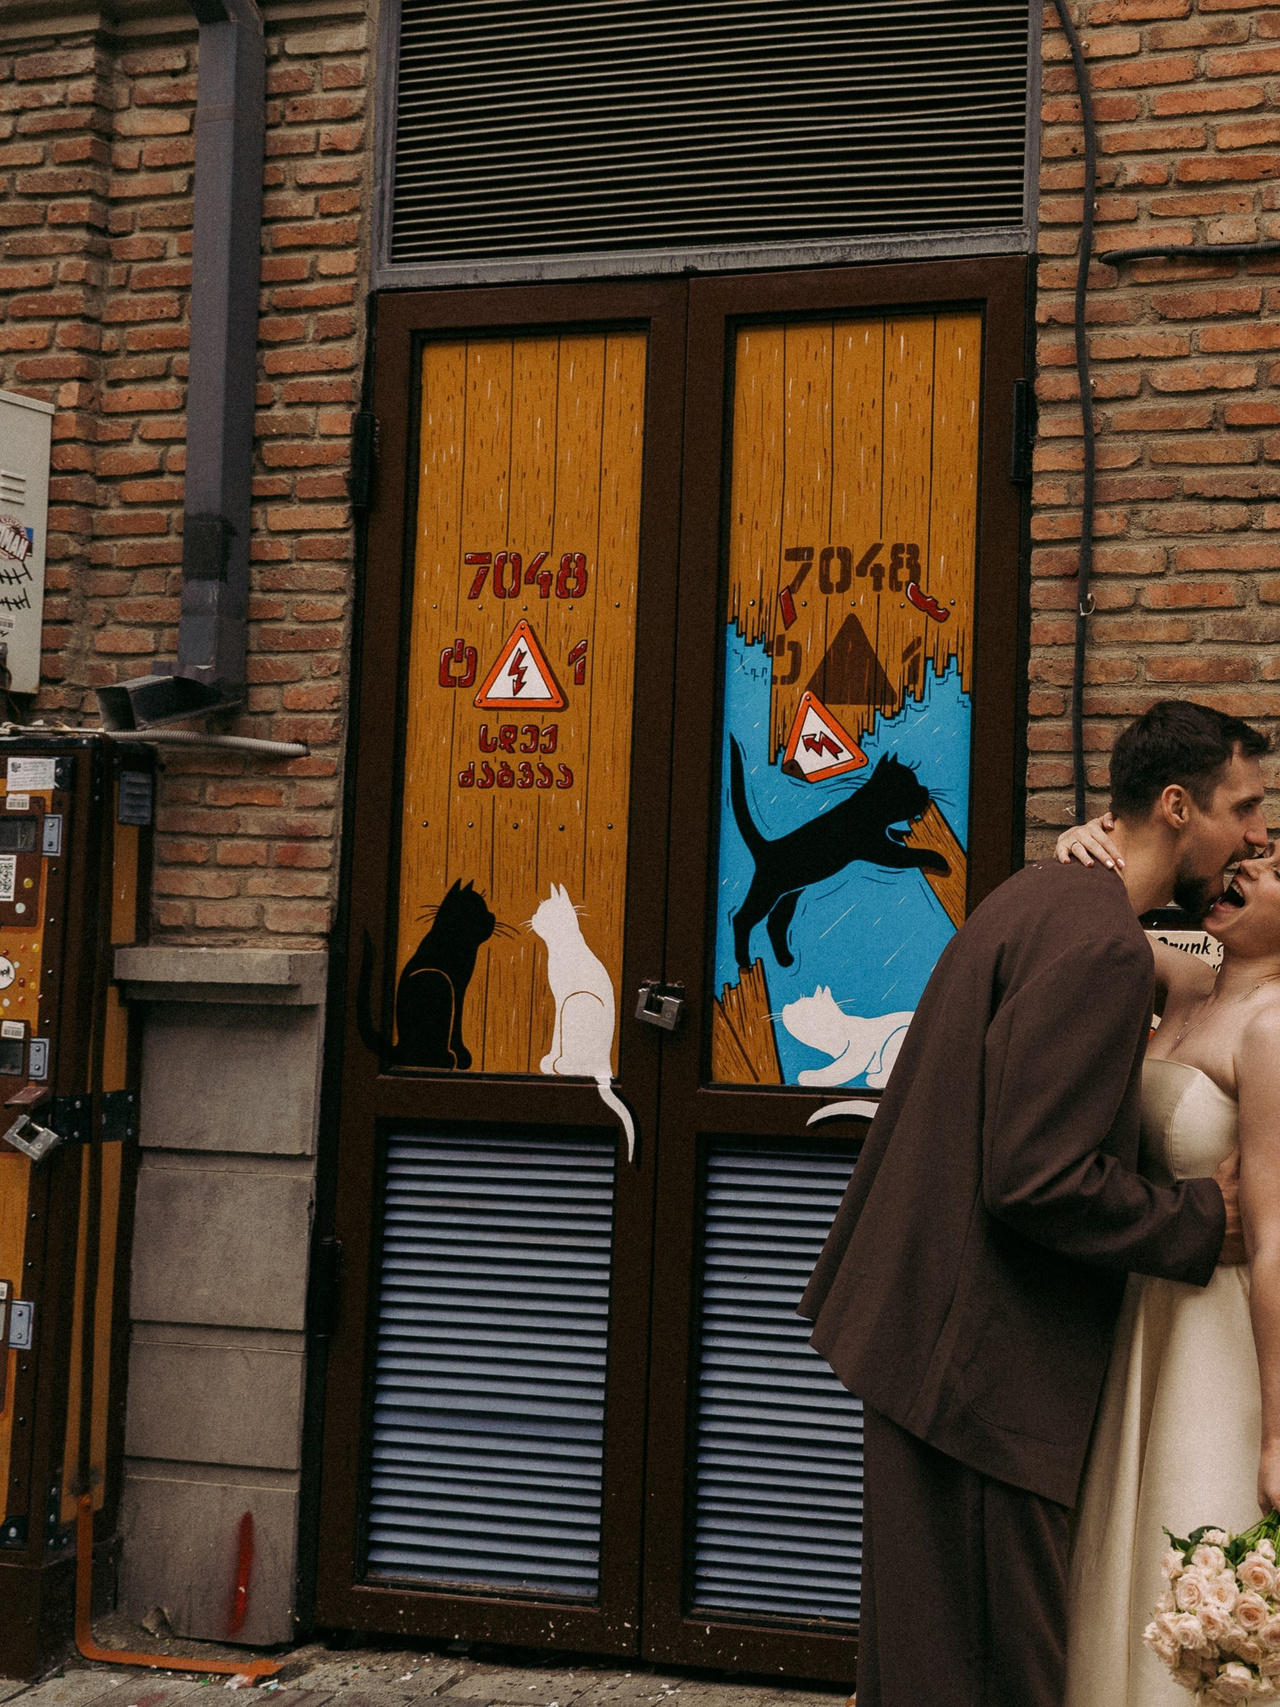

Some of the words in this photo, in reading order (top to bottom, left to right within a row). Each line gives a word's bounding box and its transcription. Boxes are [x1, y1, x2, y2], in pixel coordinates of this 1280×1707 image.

[464, 551, 588, 599] 7048
[784, 543, 921, 594] 7048
[568, 640, 588, 685] 1
[458, 761, 574, 788] ძაბვაა
